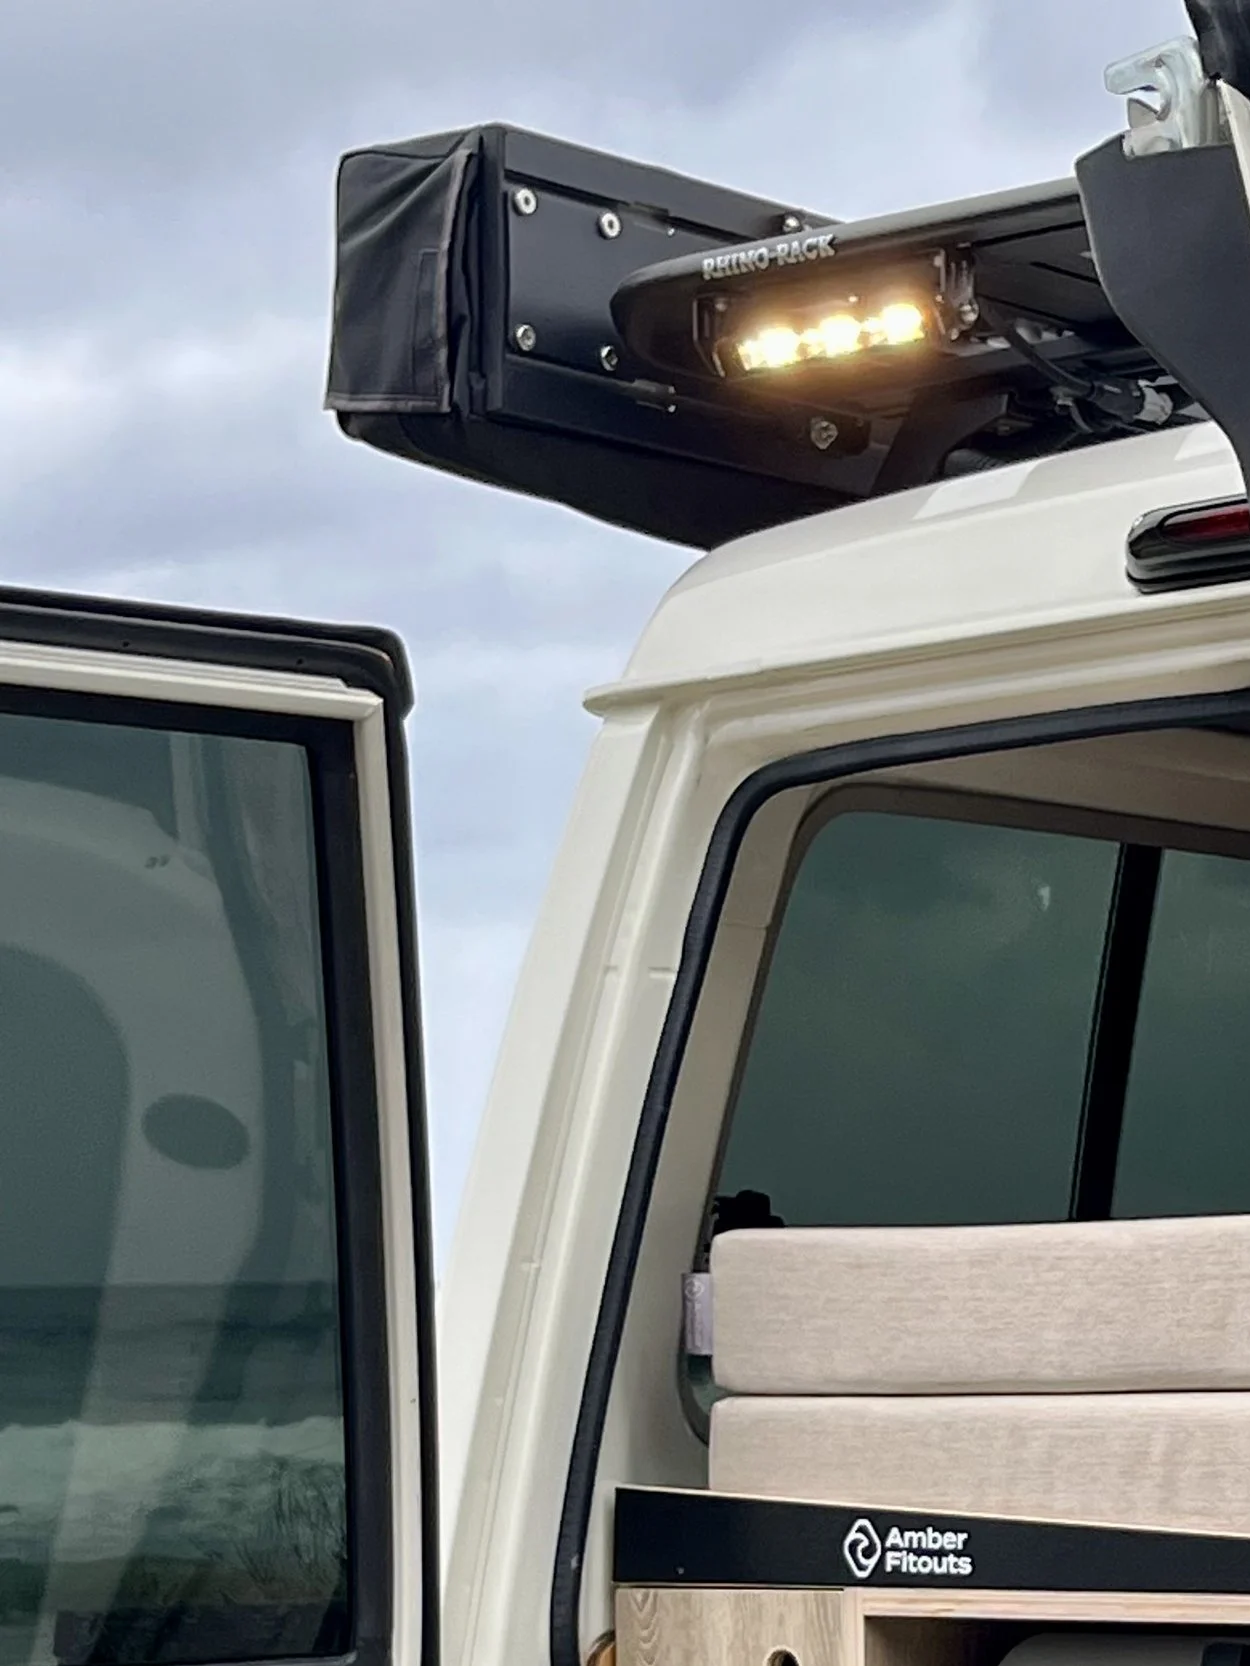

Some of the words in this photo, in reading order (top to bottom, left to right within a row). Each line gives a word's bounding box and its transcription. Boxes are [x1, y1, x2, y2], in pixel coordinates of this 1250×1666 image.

[702, 233, 836, 280] RHINO-RACK
[884, 1526, 968, 1550] Amber
[884, 1550, 973, 1575] Fitouts
